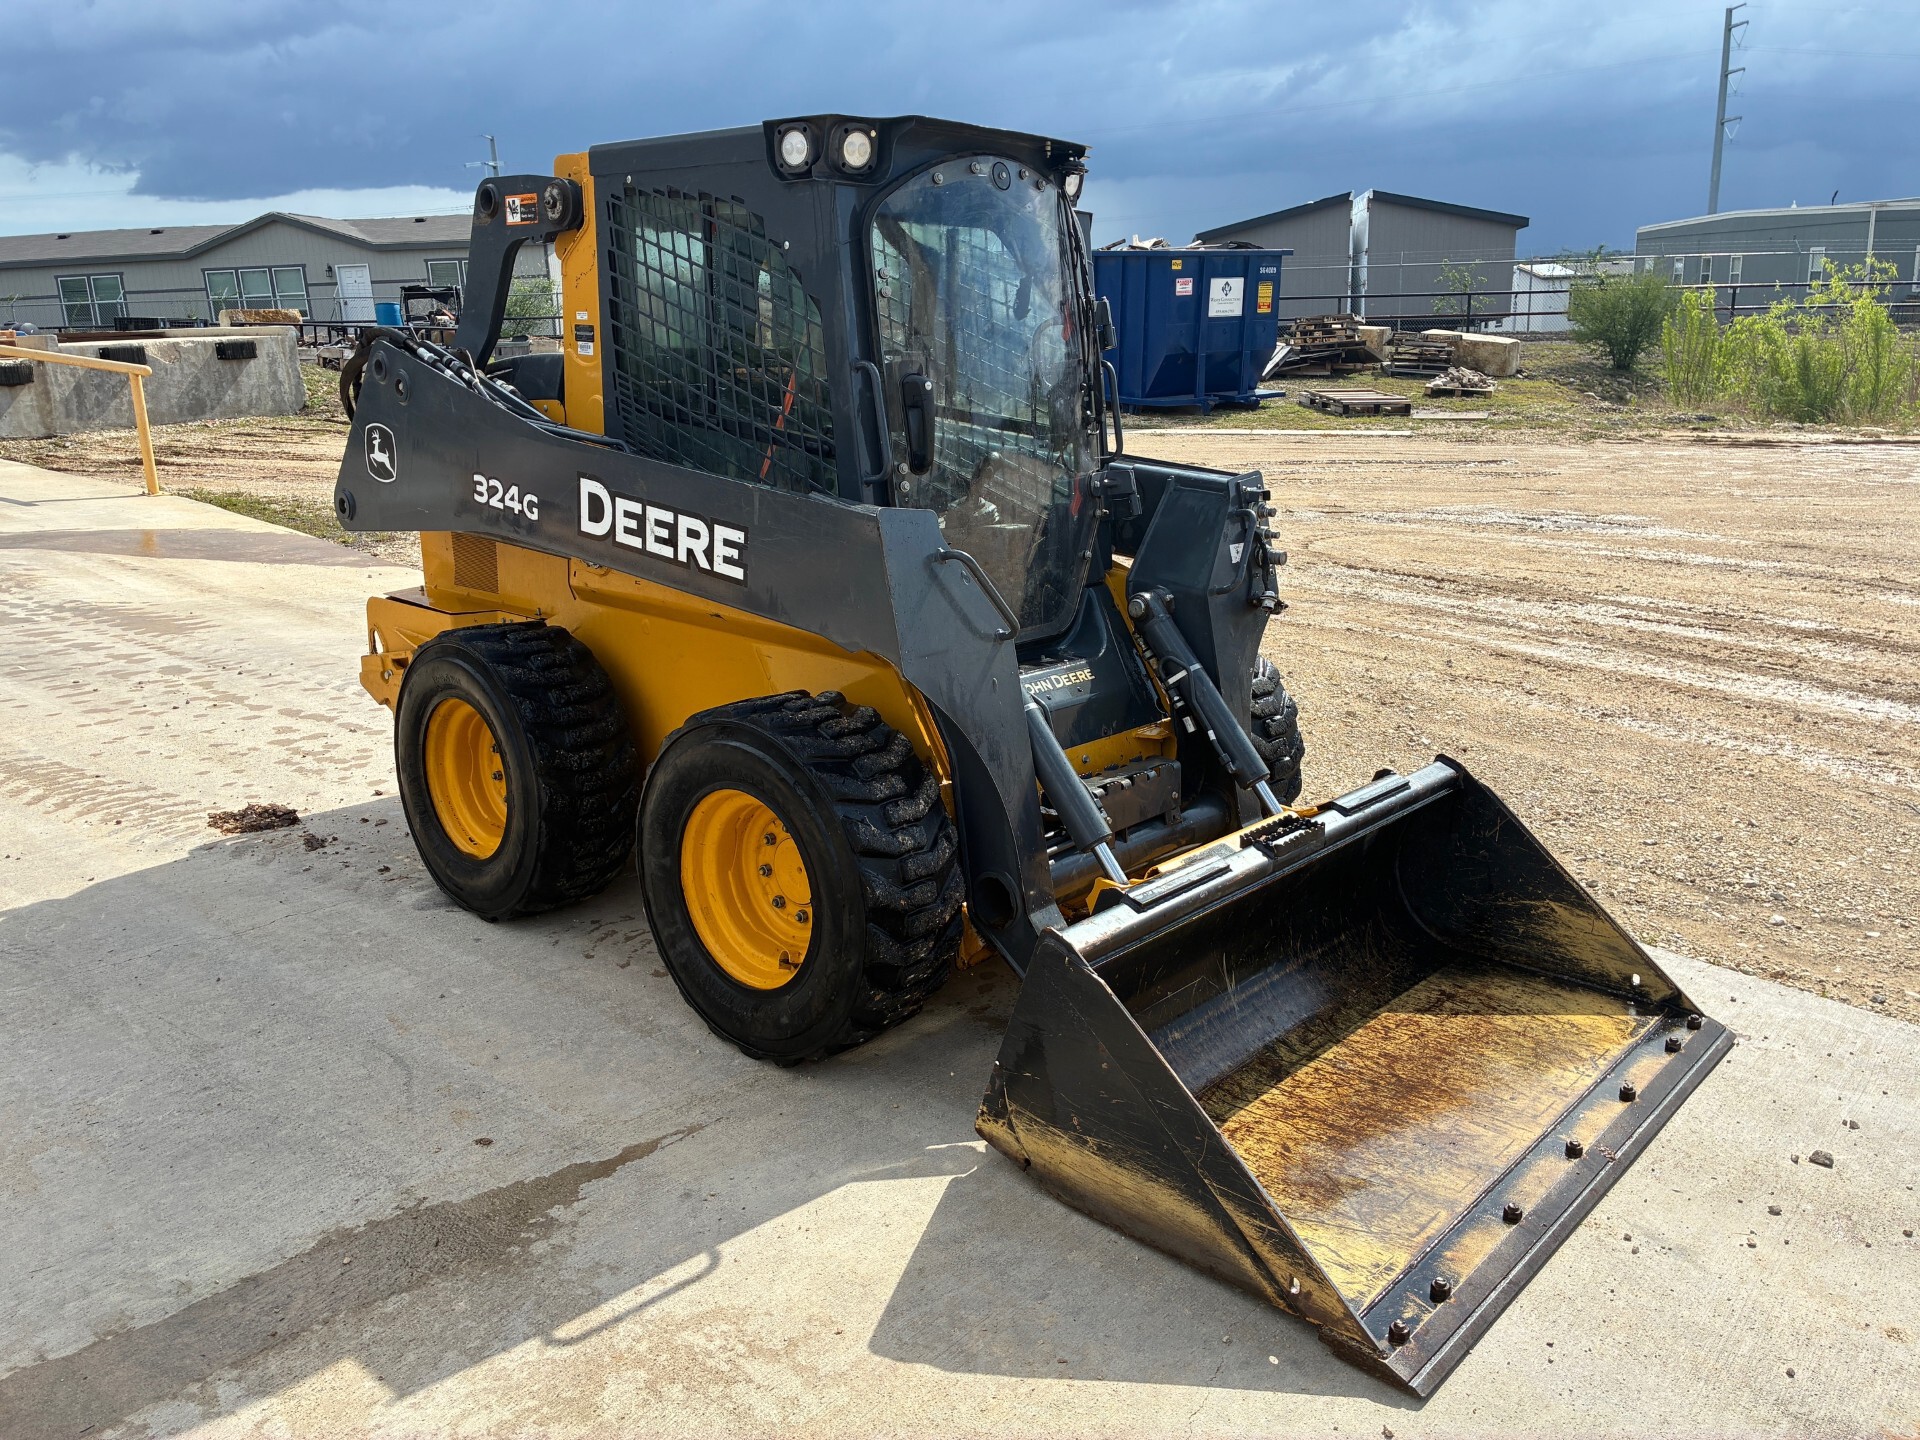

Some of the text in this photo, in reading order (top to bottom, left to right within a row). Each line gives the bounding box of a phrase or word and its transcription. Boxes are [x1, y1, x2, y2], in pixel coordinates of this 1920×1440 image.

[473, 474, 539, 521] 324G
[579, 478, 746, 580] DEERE
[1024, 669, 1095, 694] OHN DEERE
